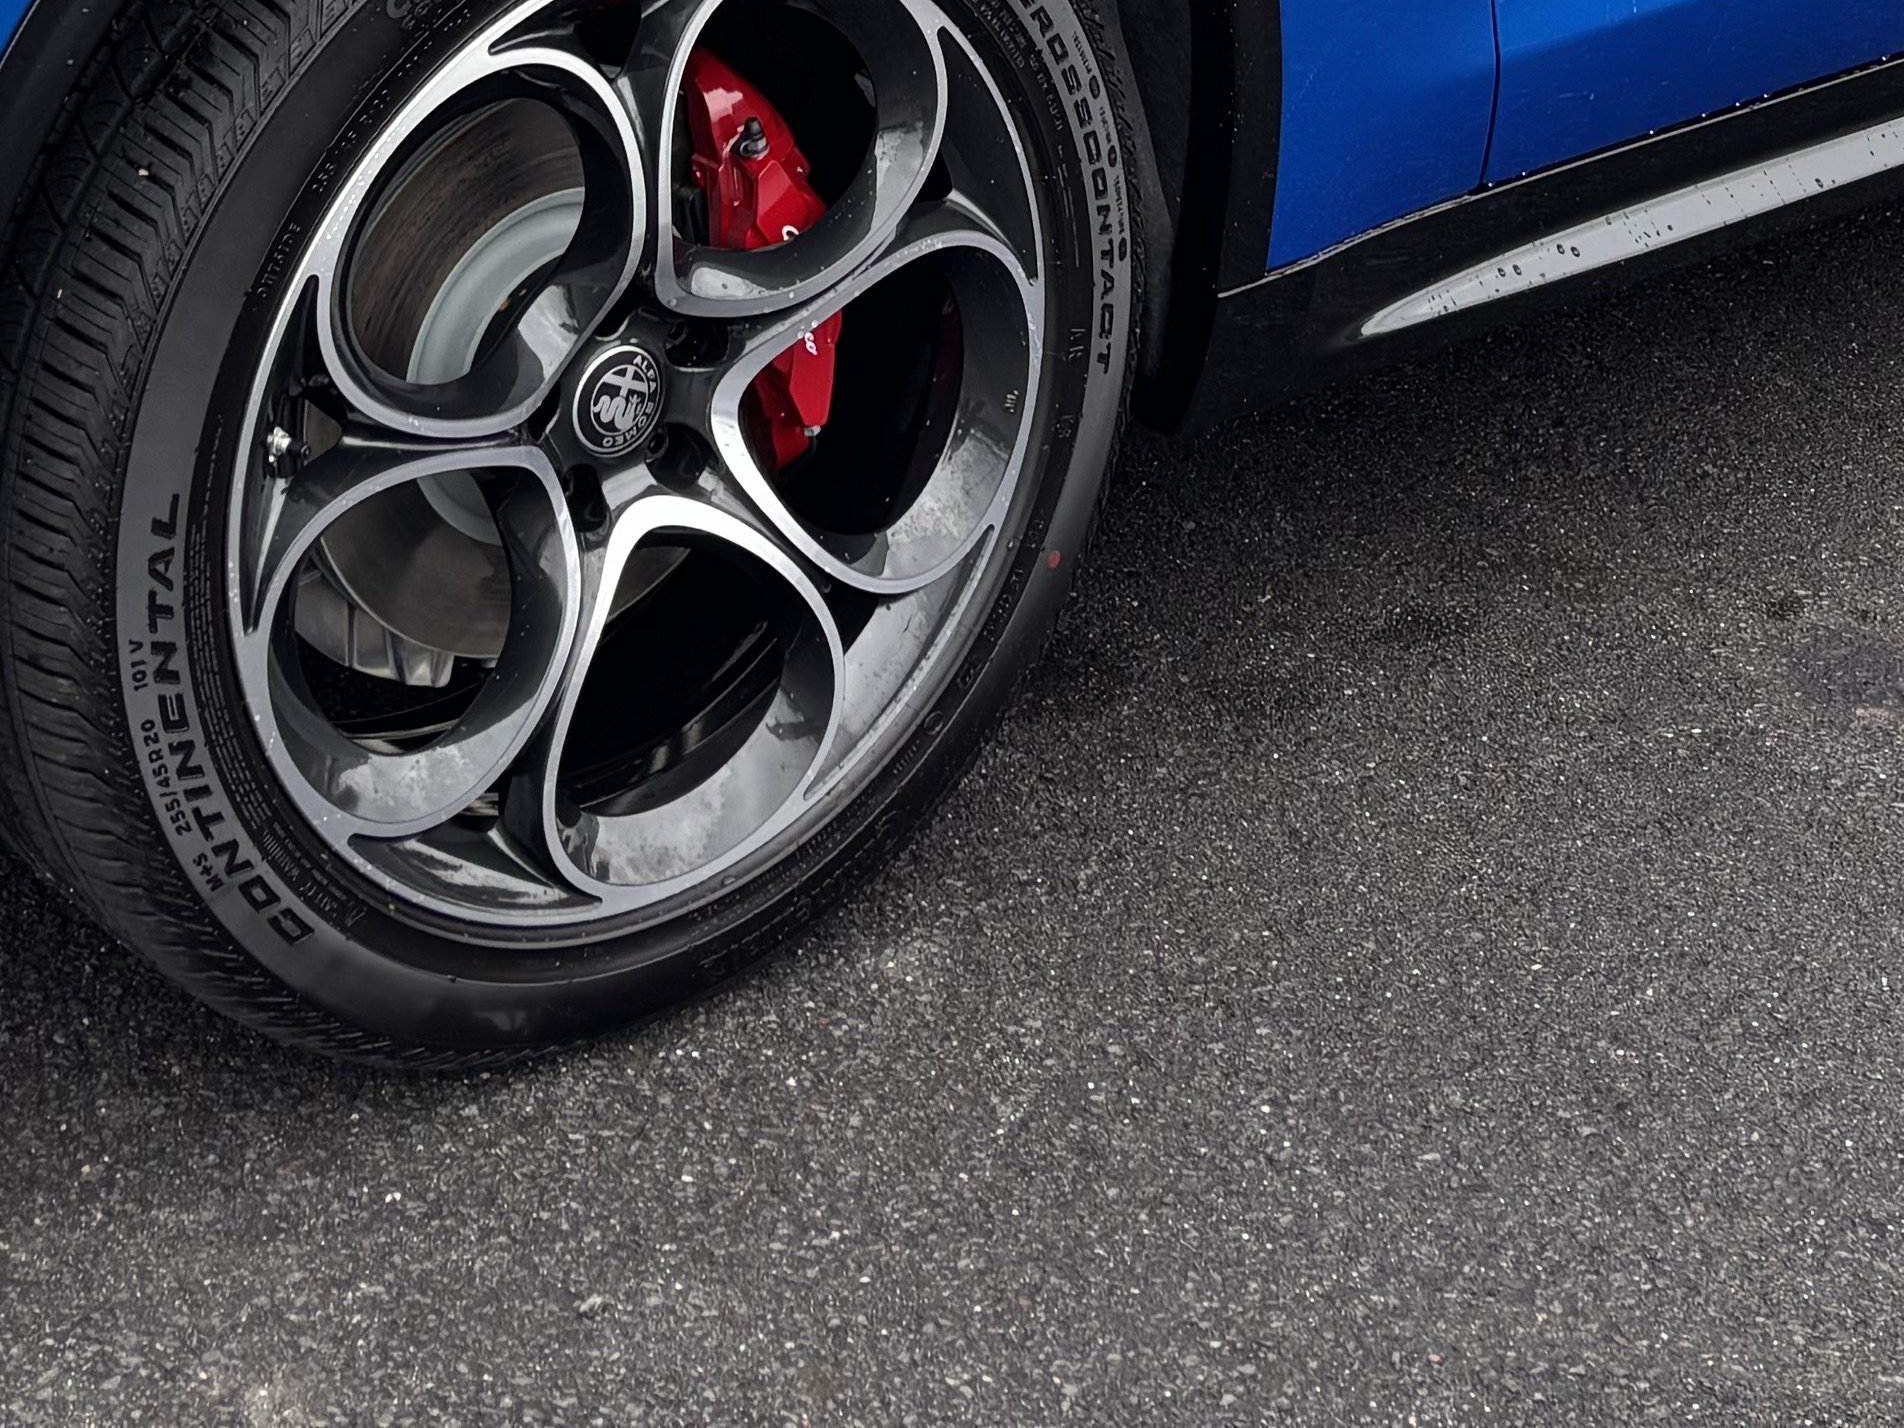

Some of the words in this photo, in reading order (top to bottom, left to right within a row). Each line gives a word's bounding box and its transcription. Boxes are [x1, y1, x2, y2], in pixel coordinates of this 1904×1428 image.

[633, 354, 657, 393] ALFA
[603, 402, 654, 447] ROMEO
[147, 493, 315, 948] CONTINENTAL
[192, 850, 225, 895] M+S
